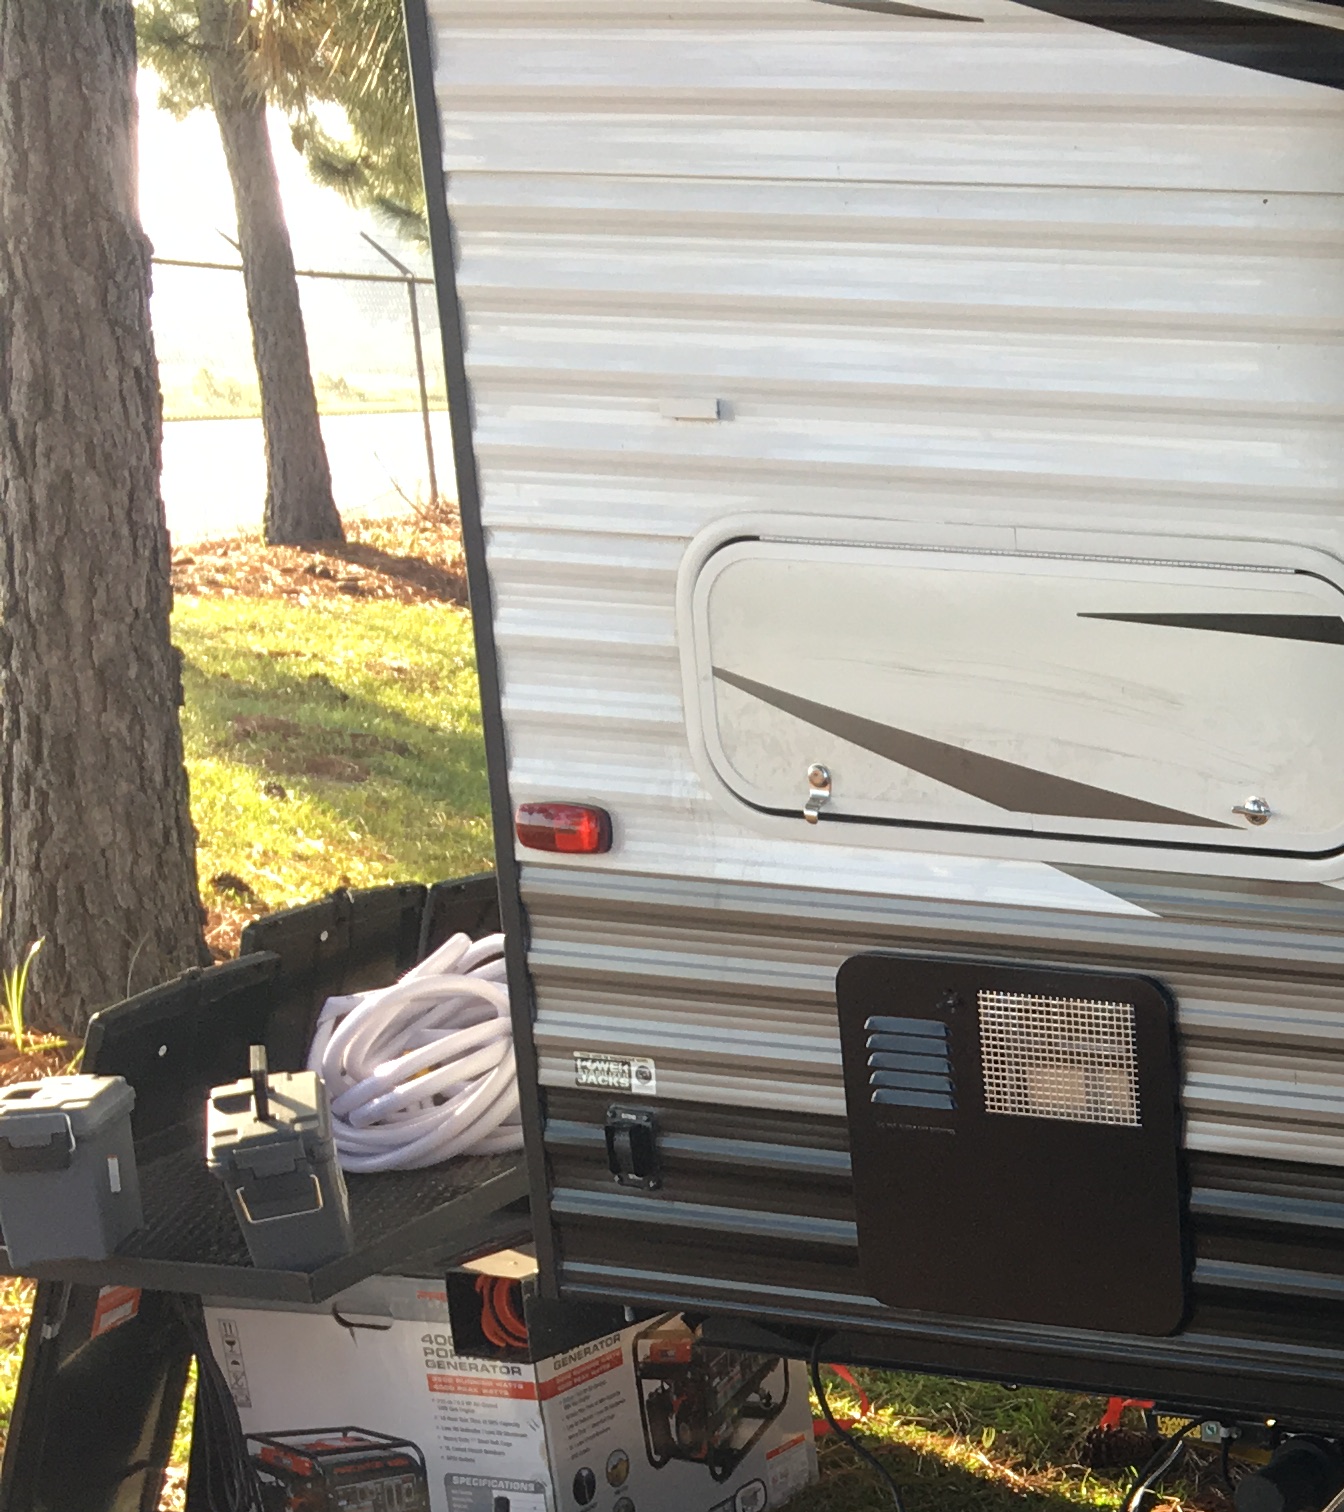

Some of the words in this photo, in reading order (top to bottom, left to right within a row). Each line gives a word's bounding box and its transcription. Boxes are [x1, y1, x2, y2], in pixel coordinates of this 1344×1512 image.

[577, 1074, 630, 1088] JACKS
[425, 1360, 522, 1376] GENERATOR
[452, 1475, 535, 1491] SPECIFICATIONS
